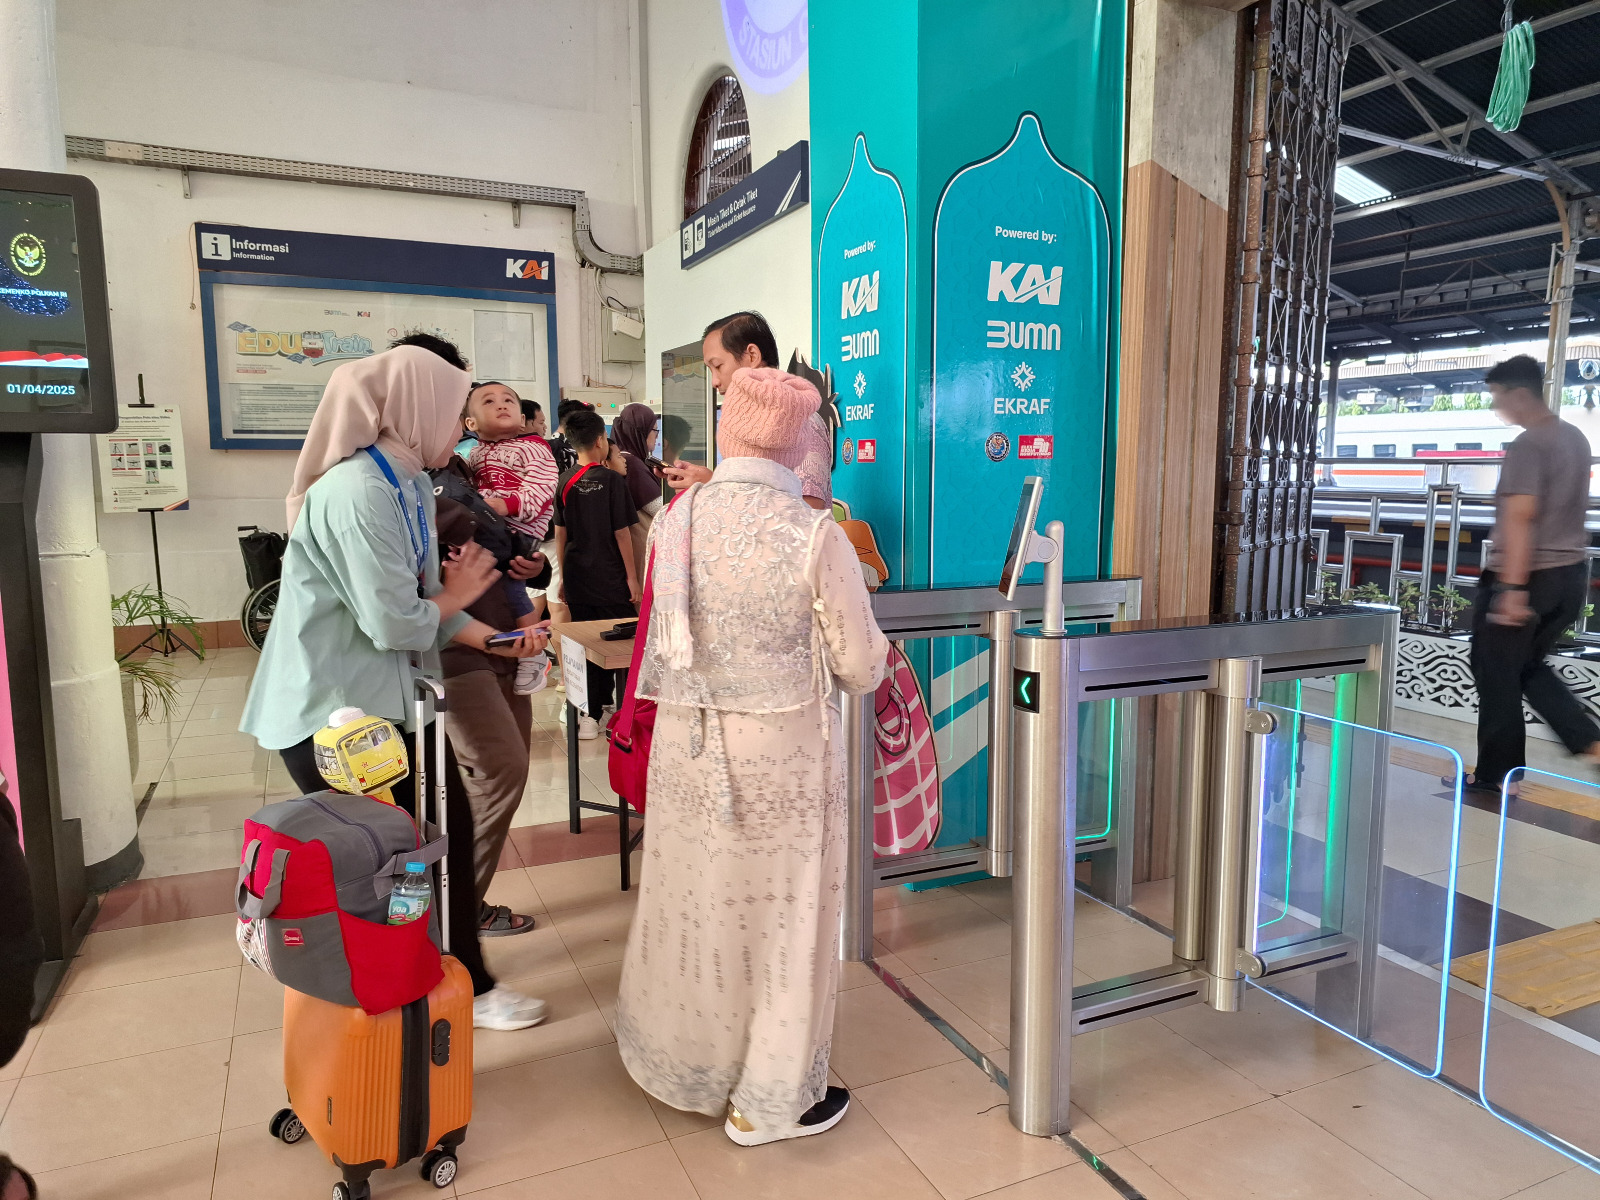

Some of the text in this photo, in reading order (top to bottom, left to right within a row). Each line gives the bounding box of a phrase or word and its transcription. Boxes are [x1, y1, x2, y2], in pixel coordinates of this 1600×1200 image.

[746, 187, 758, 203] Tiket
[995, 225, 1058, 245] Powered by:
[232, 238, 290, 254] Informasi
[233, 251, 276, 261] Information
[843, 239, 877, 260] Powered by:
[505, 258, 550, 281] KAI
[987, 260, 1064, 306] KAI
[841, 269, 880, 320] KAI
[236, 330, 372, 356] EDU Train
[841, 328, 880, 362] BUMN
[986, 319, 1062, 351] BUMN
[6, 383, 76, 395] 01/04/2025
[845, 403, 875, 422] EKRAF
[994, 397, 1051, 415] EKRAF
